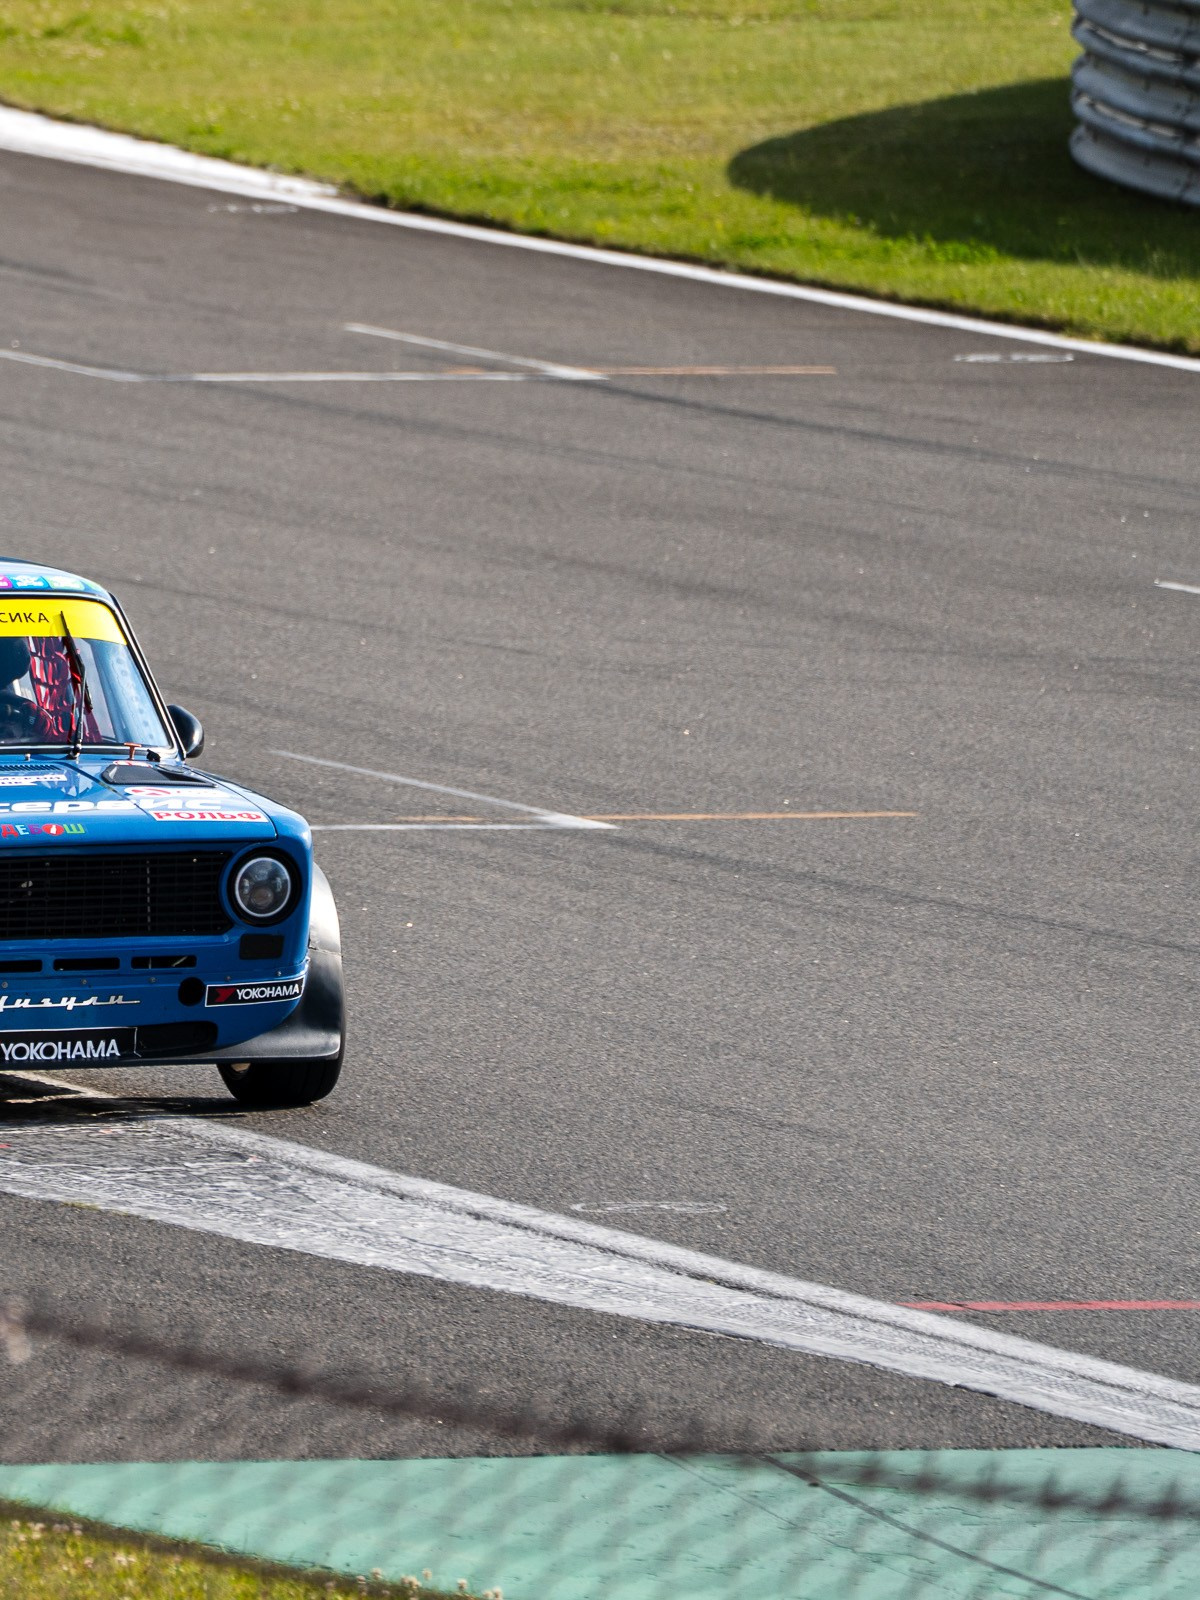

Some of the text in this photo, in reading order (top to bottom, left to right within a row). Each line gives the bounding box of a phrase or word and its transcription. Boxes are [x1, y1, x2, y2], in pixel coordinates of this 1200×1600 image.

[154, 812, 262, 820] РОЛЬФ
[0, 823, 86, 838] ДЕБОШ
[236, 983, 300, 1000] YOKOHAMA
[0, 1039, 121, 1061] YOKOHAMA
